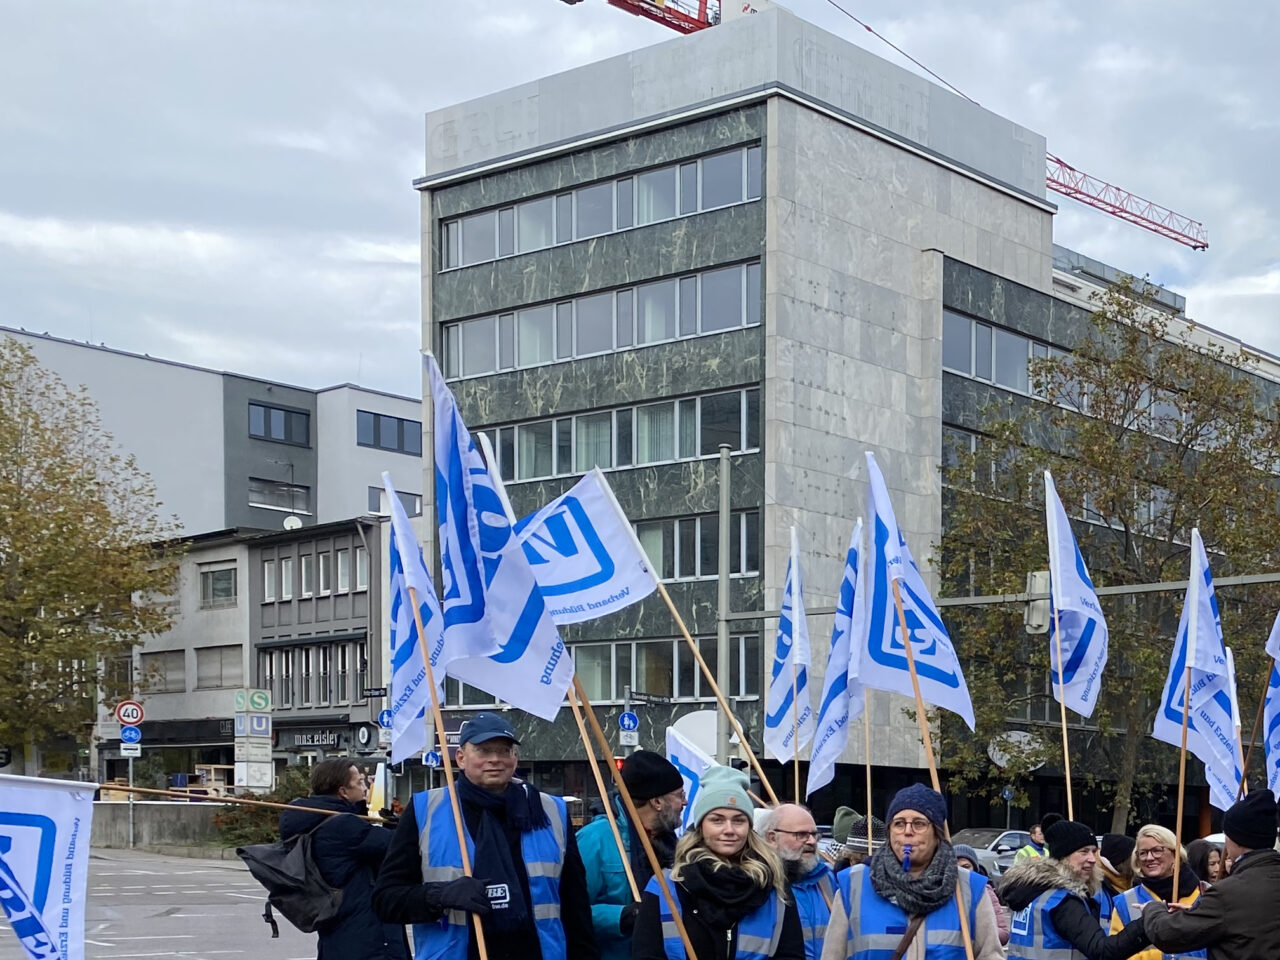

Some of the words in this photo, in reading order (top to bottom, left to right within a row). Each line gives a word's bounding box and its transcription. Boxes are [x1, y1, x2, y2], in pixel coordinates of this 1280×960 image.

[252, 693, 268, 708] S
[122, 708, 139, 719] 40
[253, 716, 266, 731] U
[314, 730, 339, 747] eisley
